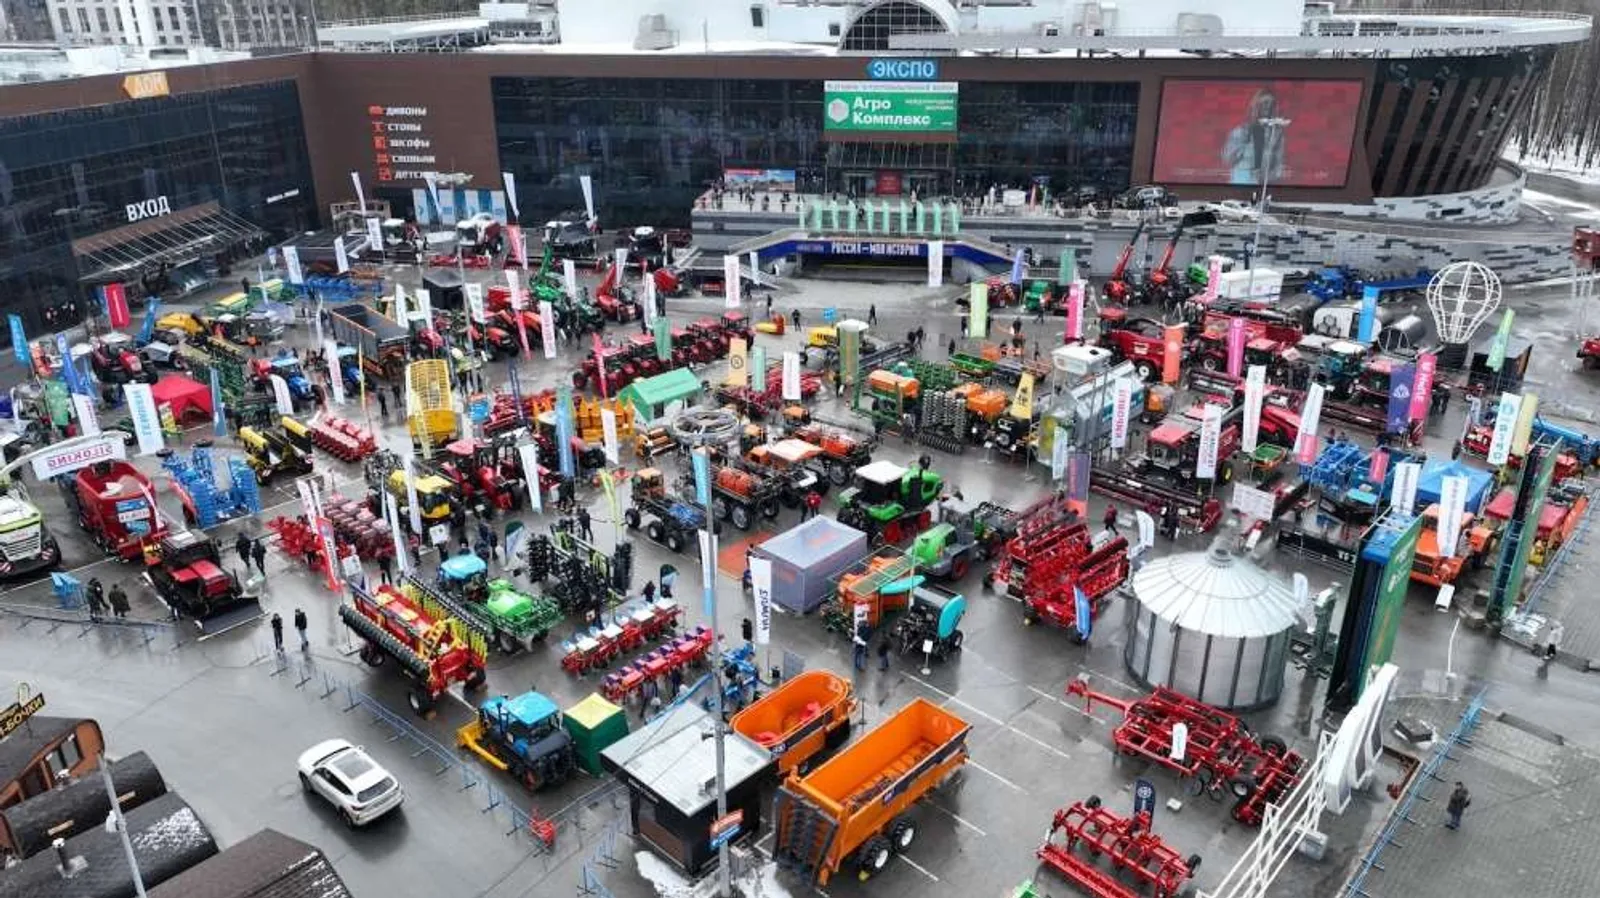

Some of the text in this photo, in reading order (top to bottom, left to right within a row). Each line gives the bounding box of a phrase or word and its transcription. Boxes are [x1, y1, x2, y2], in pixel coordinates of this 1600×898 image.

[873, 60, 935, 78] ЭКСПО
[853, 97, 892, 112] Агро
[852, 112, 931, 127] Комплекс
[126, 195, 171, 222] ВХОД
[831, 241, 862, 255] РОССИЯ
[886, 242, 920, 256] ИСТОРИЯ
